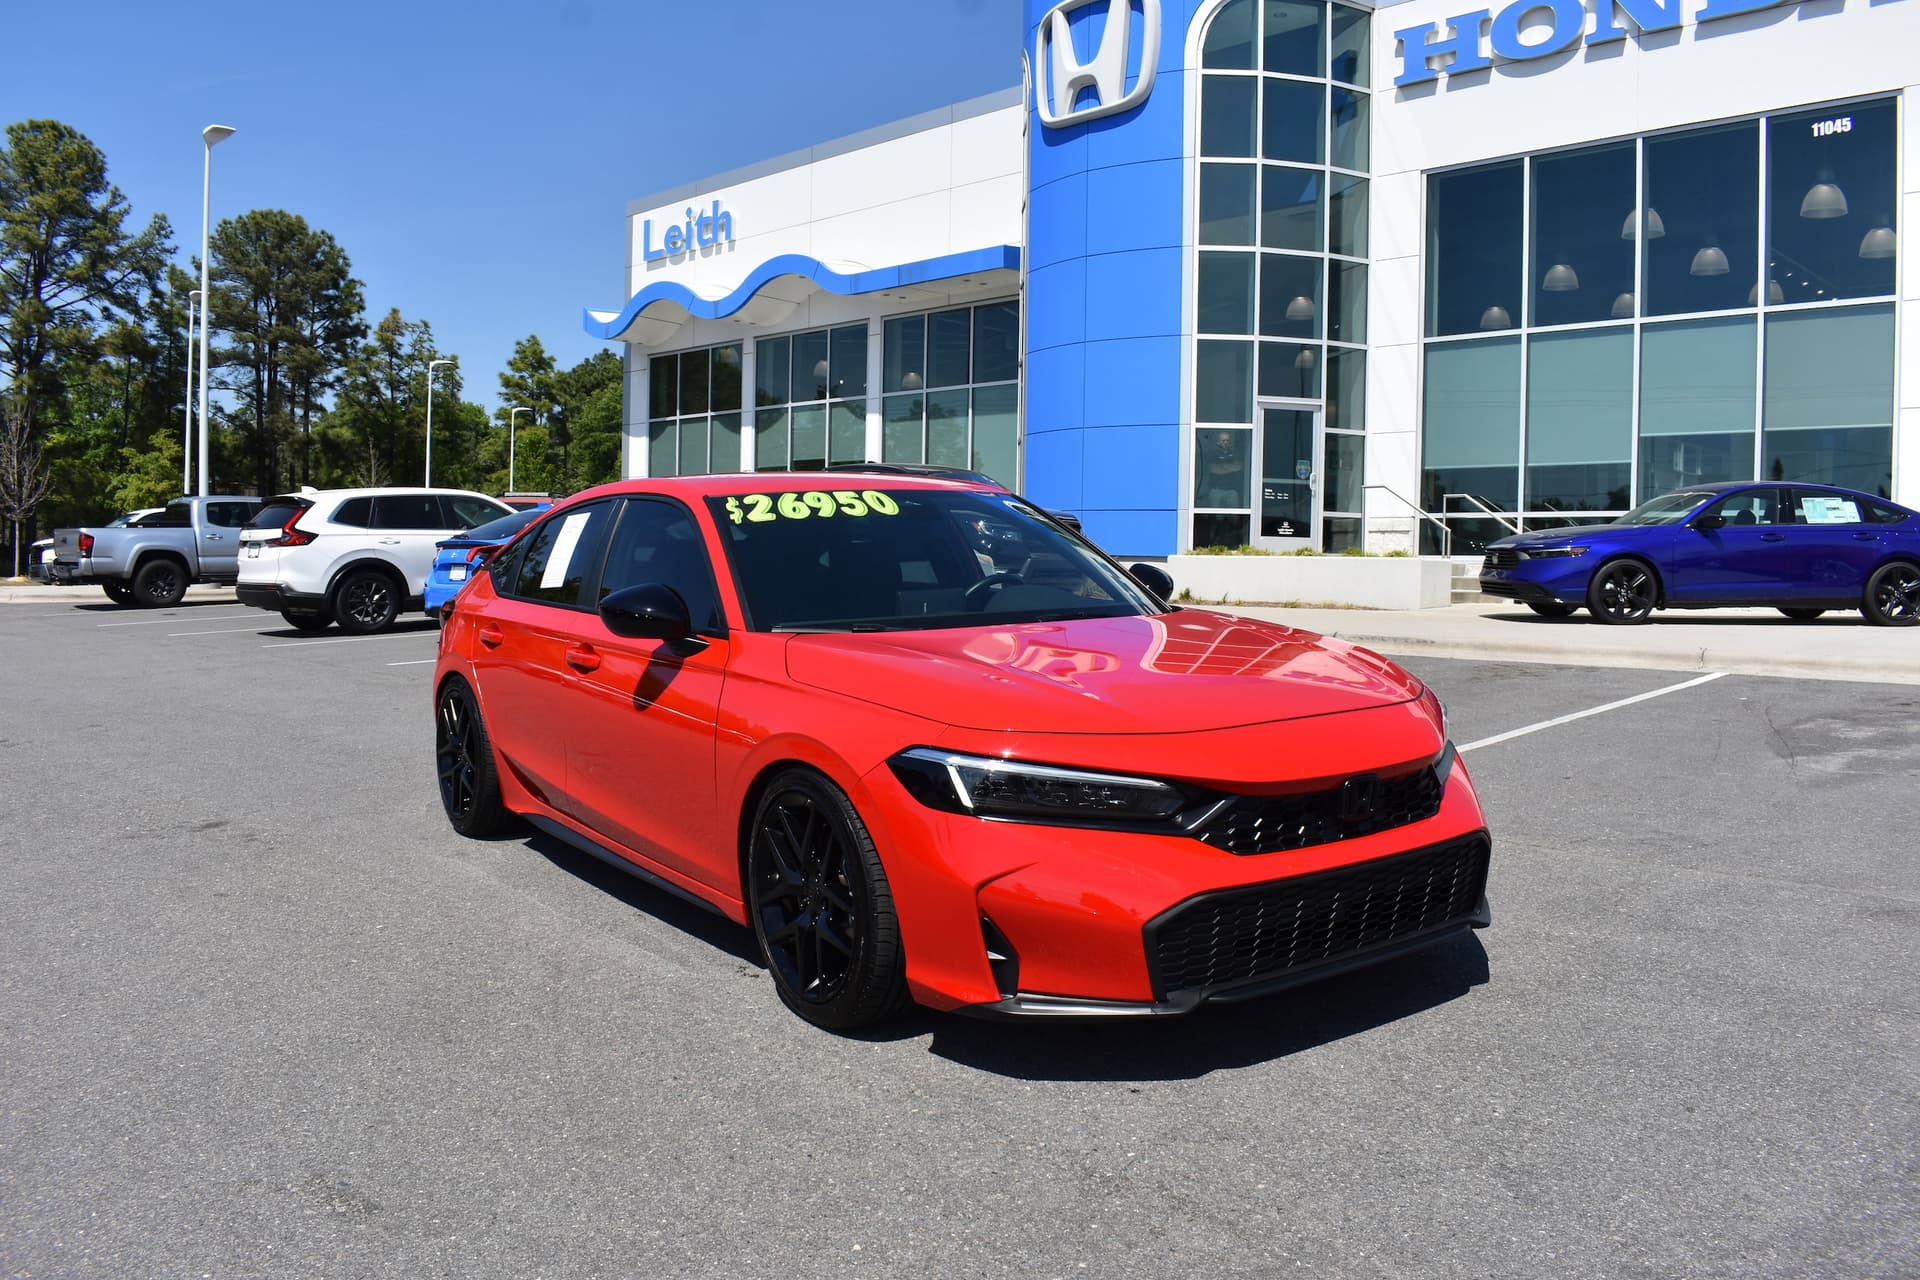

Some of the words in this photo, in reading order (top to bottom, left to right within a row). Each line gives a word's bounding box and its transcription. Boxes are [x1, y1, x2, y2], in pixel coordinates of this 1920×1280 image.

[1811, 117, 1852, 137] 11045
[643, 199, 732, 261] Leith
[725, 490, 900, 524] $26950
